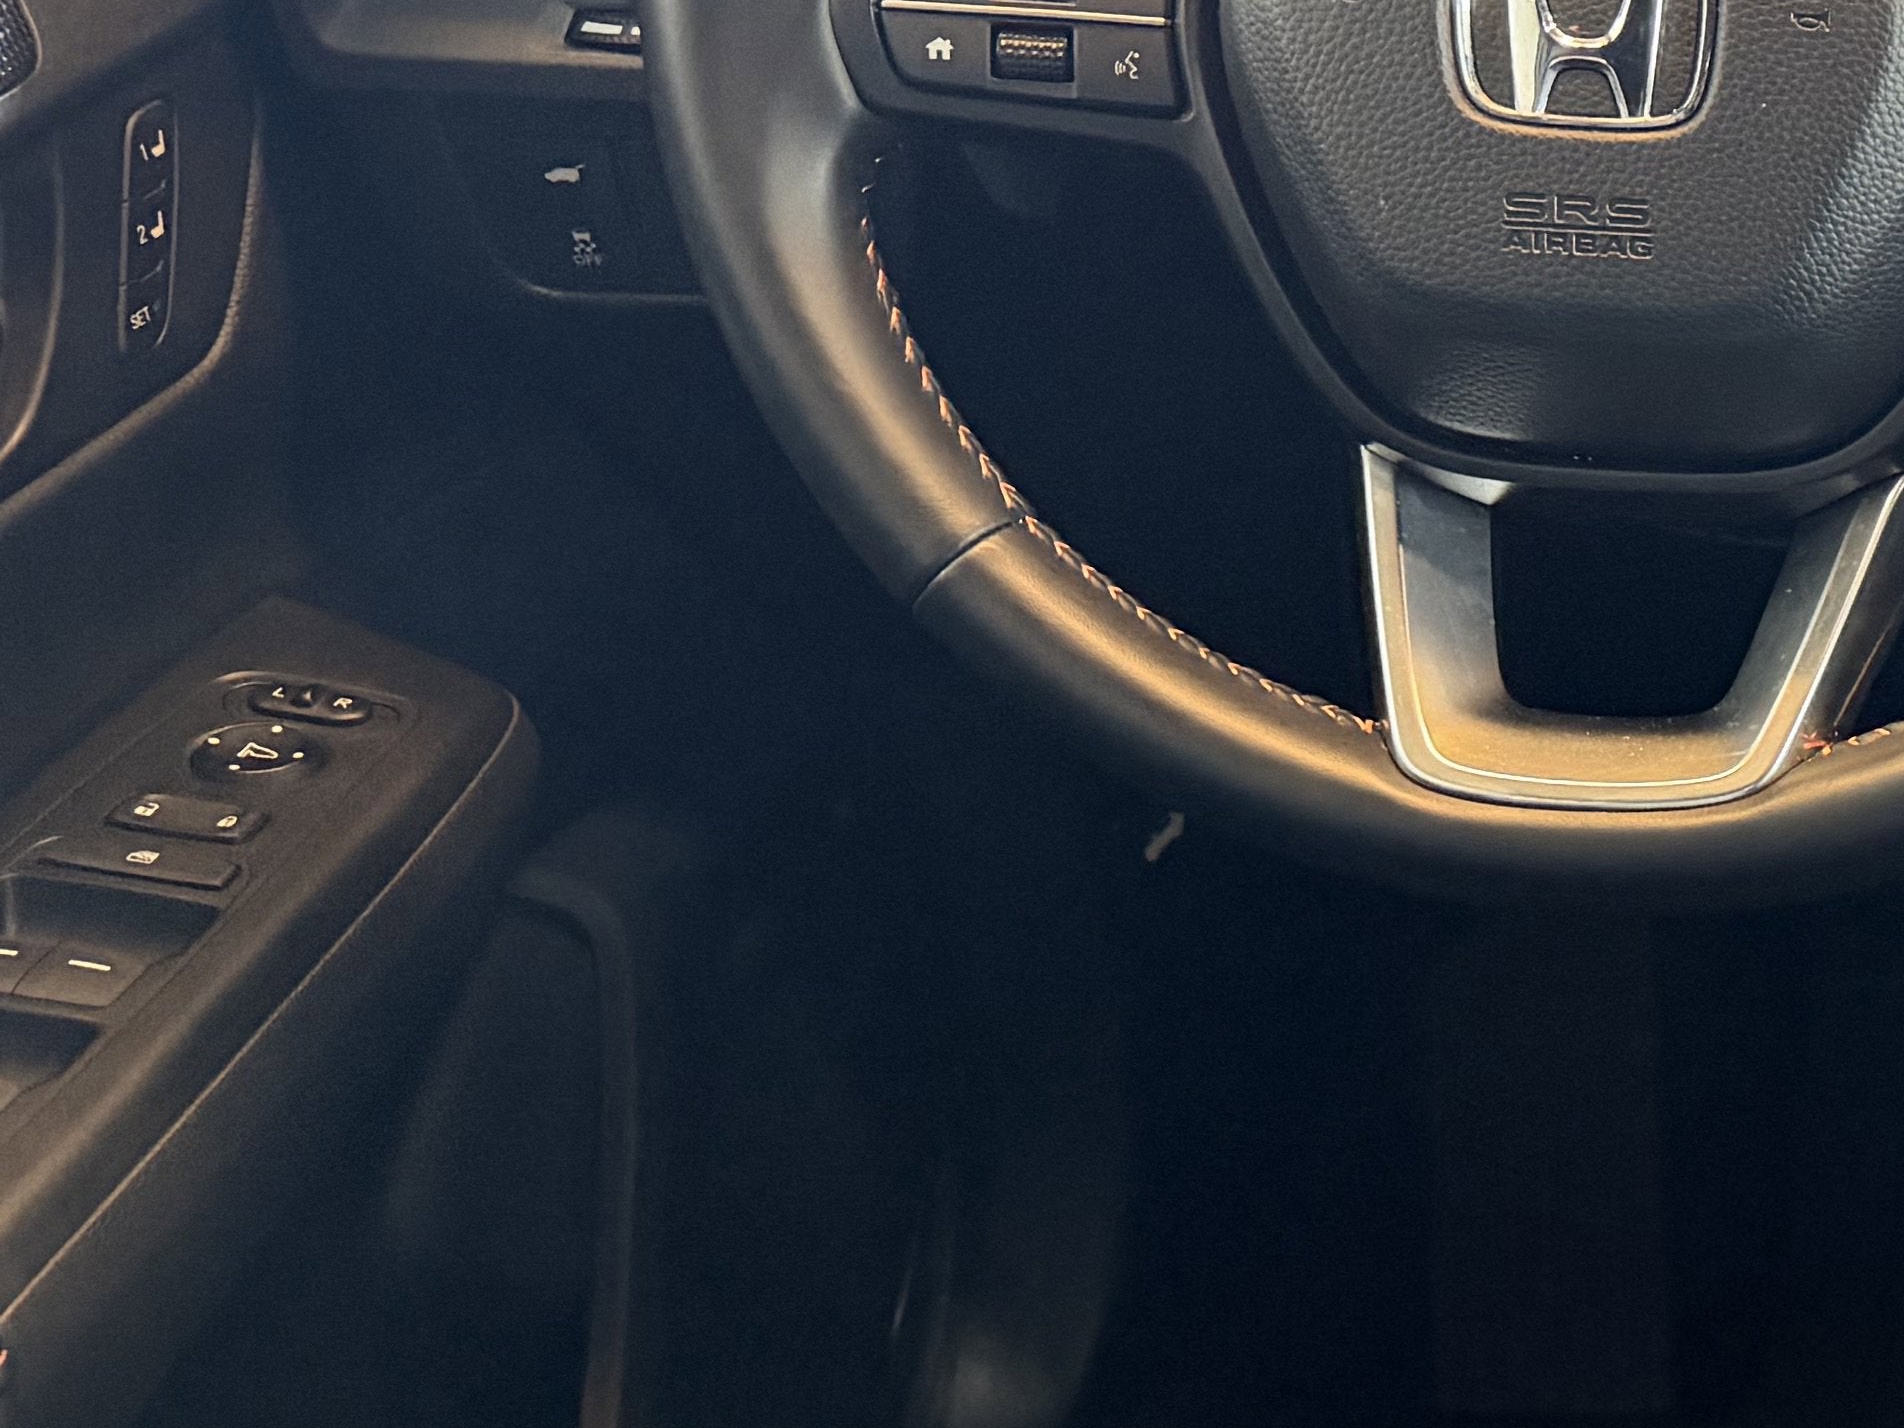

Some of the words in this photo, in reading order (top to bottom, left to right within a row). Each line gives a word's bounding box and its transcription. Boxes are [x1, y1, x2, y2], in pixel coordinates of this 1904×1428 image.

[139, 143, 149, 161] 1
[1502, 192, 1651, 228] SRS
[136, 225, 149, 245] 2
[1502, 233, 1654, 260] AIRBAG
[130, 306, 150, 330] SET
[333, 697, 353, 709] R
